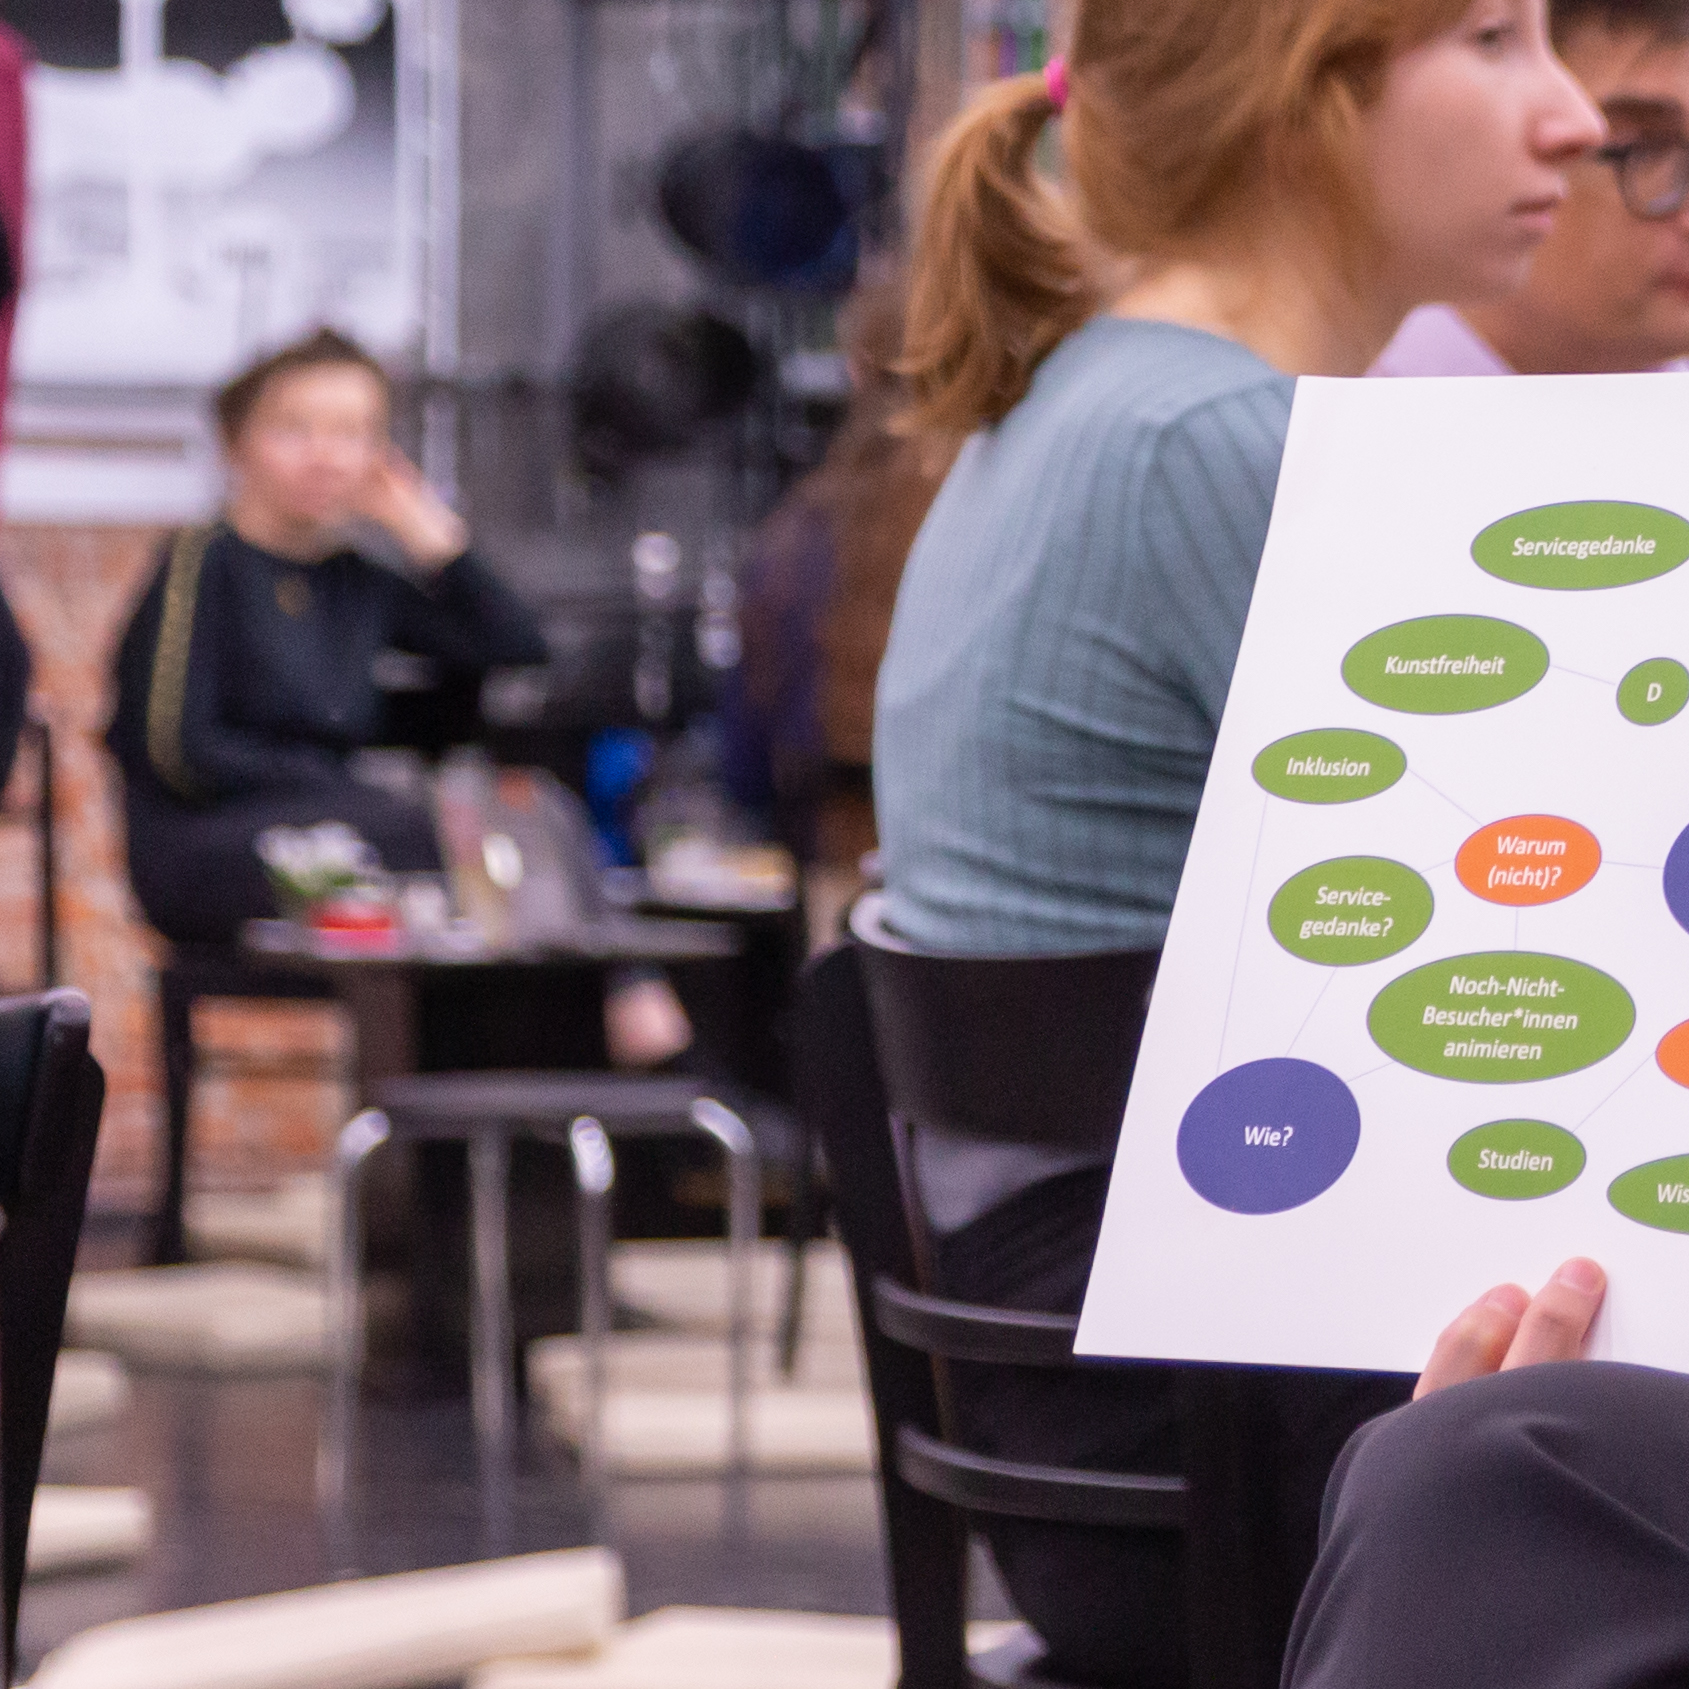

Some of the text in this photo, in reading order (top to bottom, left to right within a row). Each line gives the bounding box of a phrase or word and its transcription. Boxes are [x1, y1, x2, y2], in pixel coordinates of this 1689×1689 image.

[1511, 534, 1657, 560] Servicegedanke
[1384, 654, 1506, 675] Kunstfreiheit
[1646, 682, 1663, 703] D
[1286, 755, 1371, 777] Inklusion
[1497, 835, 1567, 856] Warum
[1487, 864, 1563, 891] (nicht)?
[1315, 885, 1392, 907] Service-
[1299, 915, 1394, 940] gedanke?
[1449, 974, 1565, 998] Noch-Nicht-
[1443, 1038, 1543, 1060] animieren
[1244, 1125, 1294, 1147] Wie?
[1477, 1148, 1554, 1172] Studien
